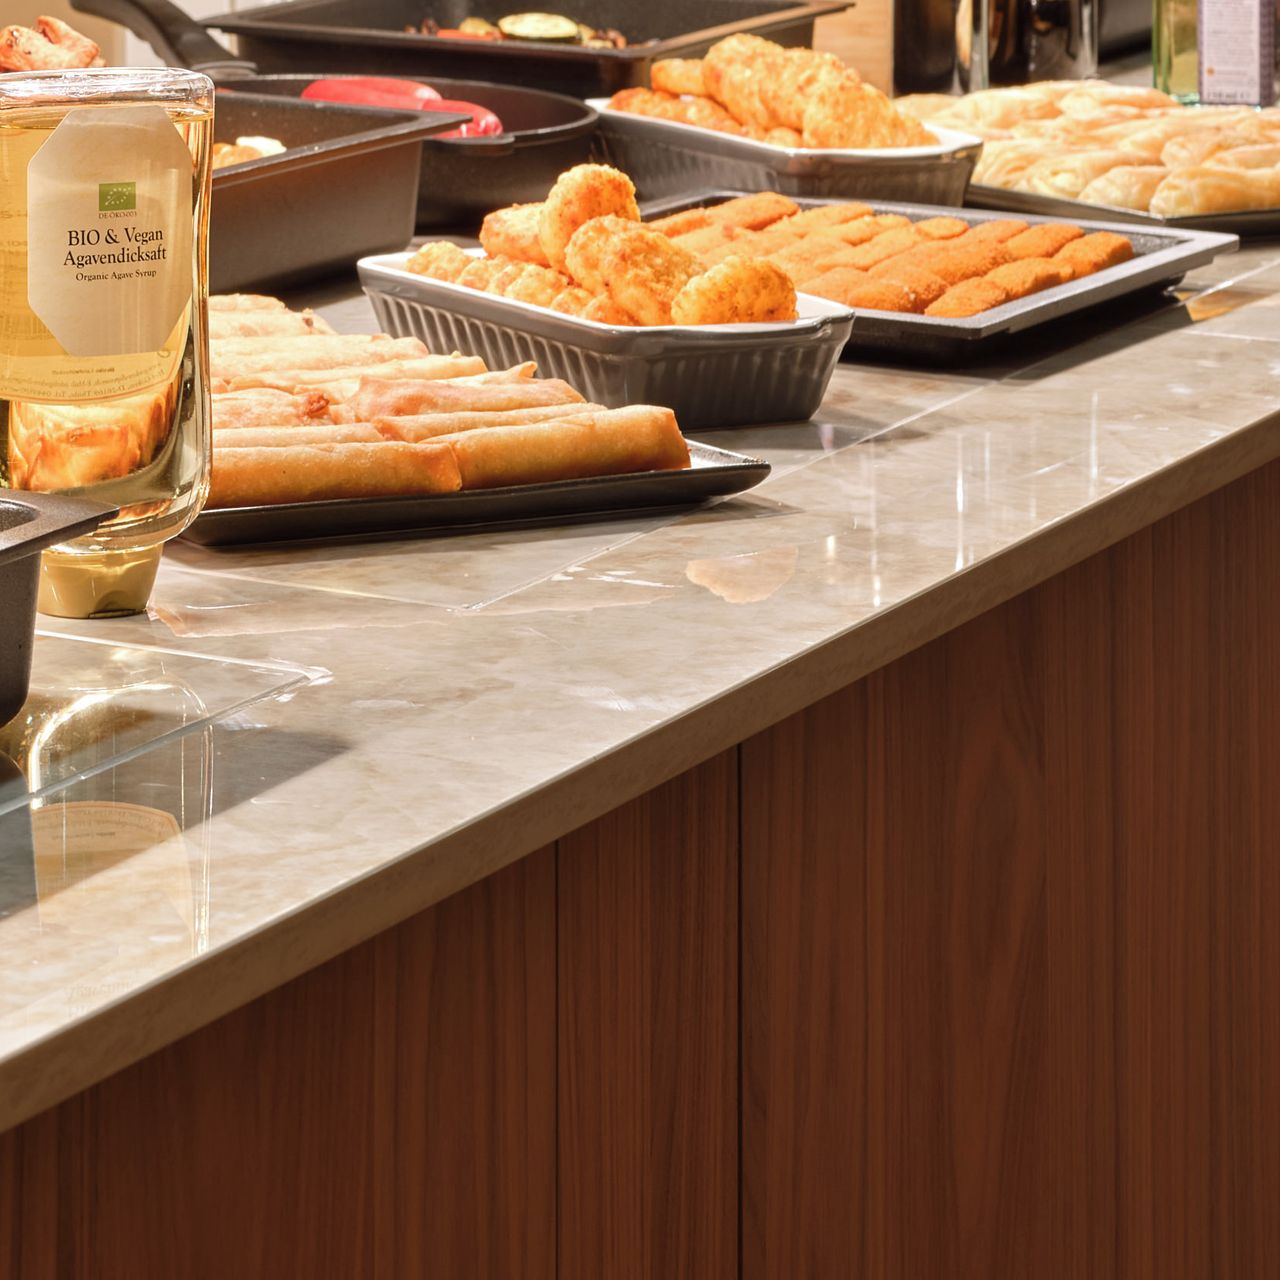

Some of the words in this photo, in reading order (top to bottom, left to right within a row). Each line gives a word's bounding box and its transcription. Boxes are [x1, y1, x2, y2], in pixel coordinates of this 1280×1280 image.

[67, 229, 100, 246] BIO
[105, 228, 120, 244] &
[124, 227, 163, 245] Vegan
[63, 244, 167, 268] Agavendicksaft
[75, 272, 109, 282] Organic
[111, 271, 133, 280] Agave
[135, 269, 157, 278] Syrup
